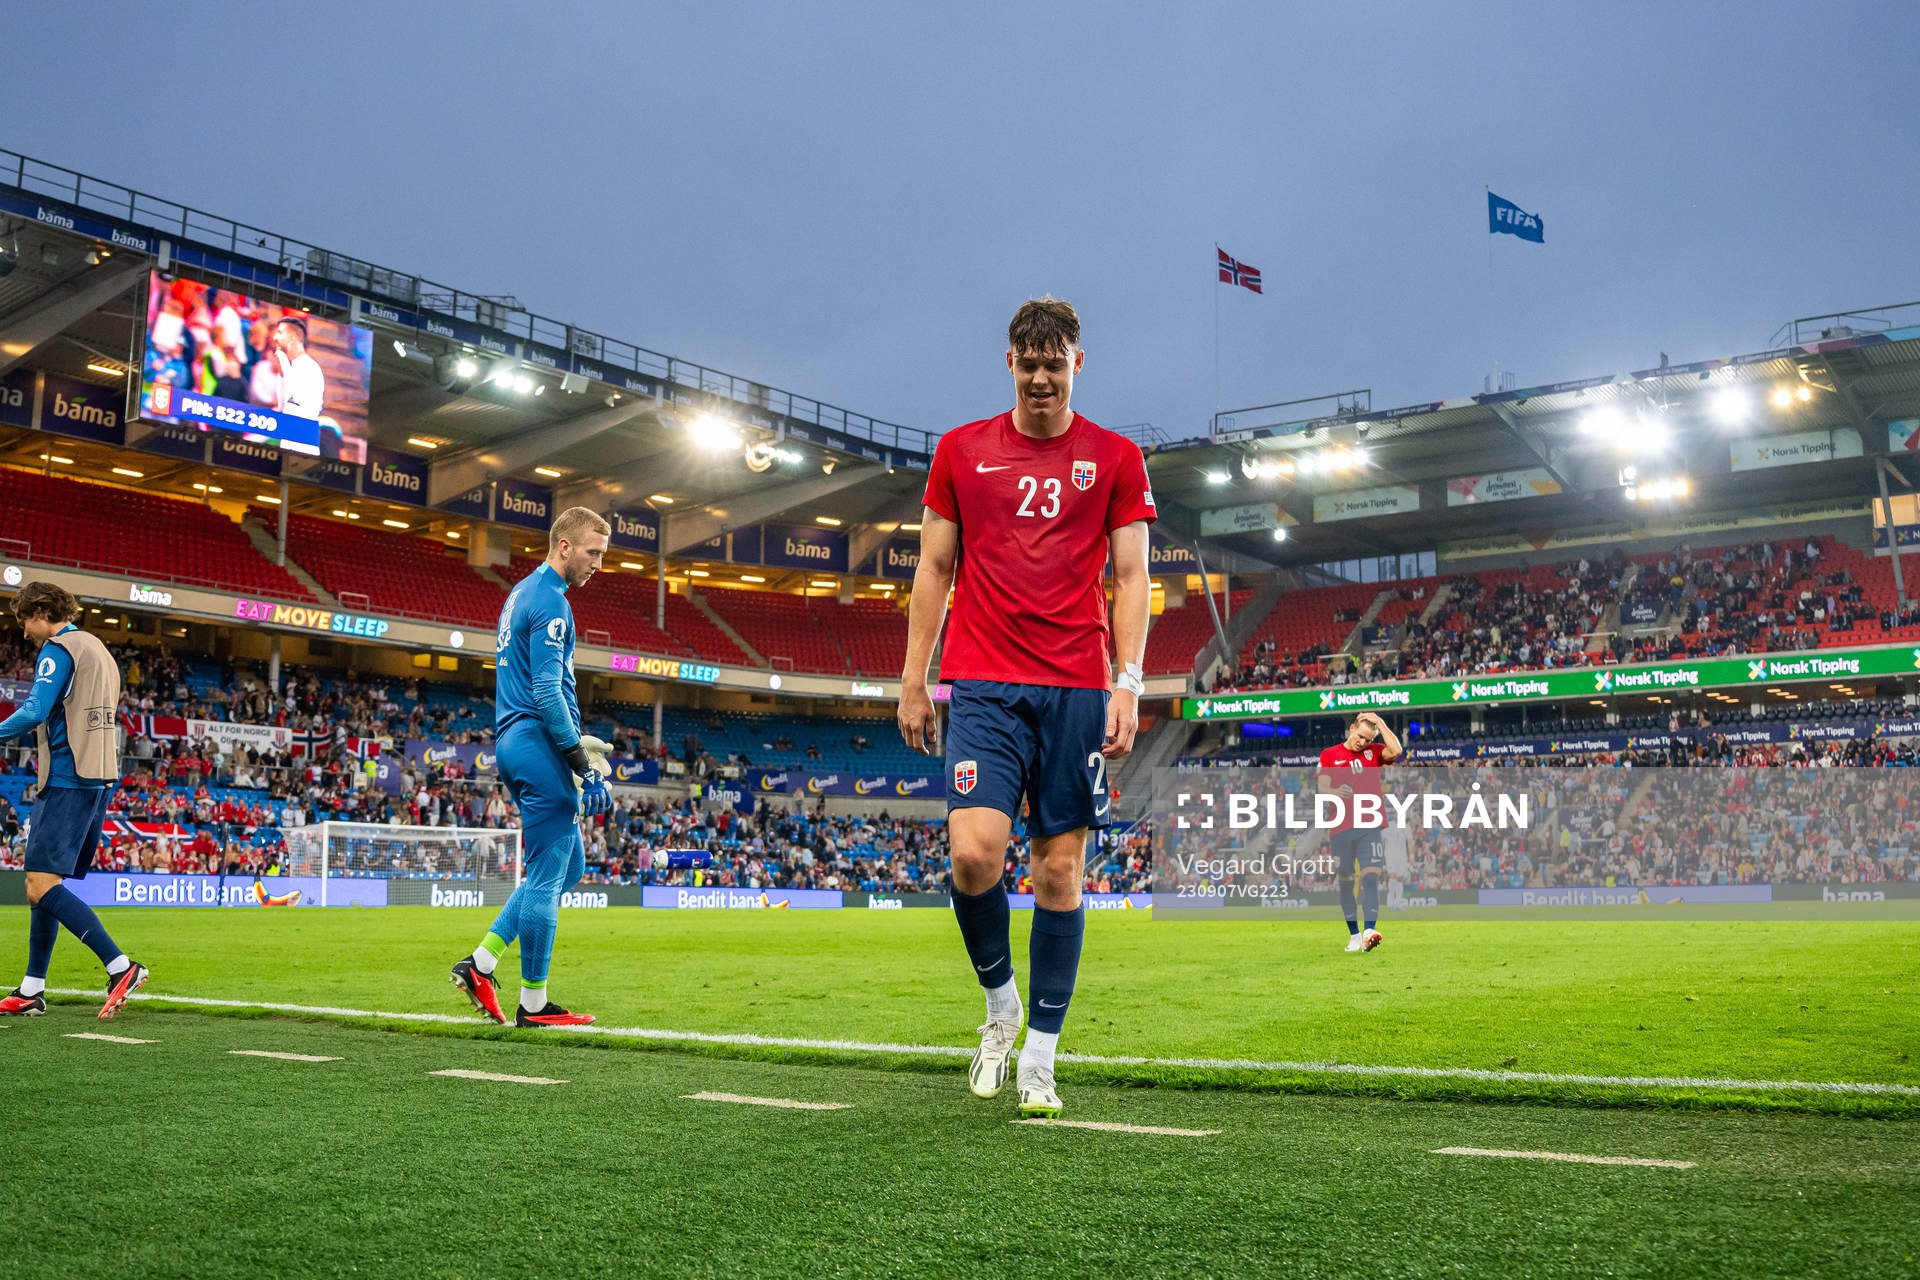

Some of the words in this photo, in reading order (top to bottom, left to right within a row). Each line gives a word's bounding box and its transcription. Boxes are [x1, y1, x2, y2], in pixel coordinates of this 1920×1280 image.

[37, 206, 74, 229] bama
[1495, 206, 1537, 229] FIFA
[111, 228, 147, 250] bama
[370, 303, 399, 322] bama
[427, 319, 454, 338] bama
[480, 335, 506, 353] bama
[53, 392, 117, 428] bama
[181, 397, 213, 418] PIN:
[215, 405, 245, 425] 522
[248, 413, 278, 431] 309
[1772, 445, 1799, 457] Norsk
[371, 461, 420, 491] bama
[503, 490, 546, 517] bama
[1016, 476, 1062, 518] 23
[1346, 500, 1369, 511] Norsk
[1370, 497, 1398, 508] Tipping
[617, 515, 656, 541] bama
[785, 538, 831, 560] bama
[888, 548, 920, 568] bam
[130, 583, 172, 606] bama
[236, 598, 274, 621] EAT
[273, 604, 332, 630] MOVE
[332, 613, 389, 638] SLEEP
[610, 653, 639, 672] EAT
[638, 657, 680, 678] MOVE
[680, 662, 721, 682] SLEEP
[1770, 662, 1808, 676] Norsk
[1809, 658, 1860, 674] Tipping
[1615, 674, 1651, 687] Norsk
[1652, 669, 1698, 685] Tipping
[1337, 693, 1367, 706] Norsk
[1367, 690, 1410, 705] Tipping
[1471, 683, 1504, 697] Norsk
[1505, 681, 1549, 696] Tipping
[1213, 701, 1242, 714] Norsk
[1243, 698, 1280, 713] Tipping
[208, 725, 223, 733] ALT
[225, 726, 241, 735] FOR
[243, 727, 271, 737] NORGE
[1803, 728, 1824, 737] Norsk
[1825, 726, 1855, 737] Tipping
[1889, 722, 1912, 732] Norsk
[1488, 745, 1508, 755] Norsk
[1509, 744, 1534, 754] Tipping
[1562, 741, 1583, 751] Norsk
[1583, 740, 1609, 750] Tipping
[1639, 737, 1662, 747] Norsk
[1416, 749, 1436, 758] Norsk
[1436, 748, 1460, 758] Tipping
[1349, 758, 1363, 775] 10
[708, 784, 741, 803] bama
[1371, 841, 1383, 857] 10
[115, 877, 196, 903] Bendit
[431, 884, 484, 907] bama
[677, 889, 727, 909] Bendit
[729, 889, 763, 909] bana
[1823, 886, 1885, 902] bama
[868, 893, 903, 909] bama
